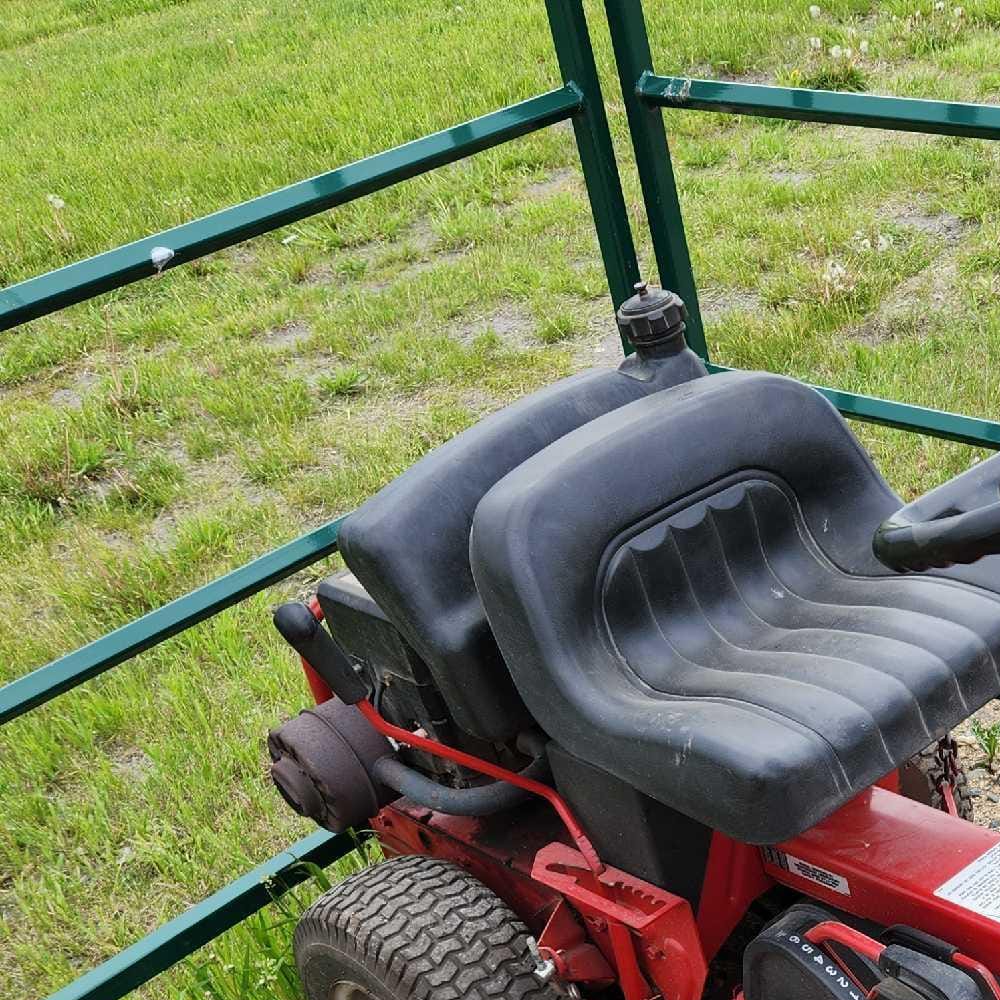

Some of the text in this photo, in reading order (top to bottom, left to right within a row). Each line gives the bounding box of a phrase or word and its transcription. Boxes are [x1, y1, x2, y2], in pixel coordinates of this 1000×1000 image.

[801, 943, 814, 954] 5
[813, 955, 824, 965] 4
[825, 965, 837, 976] 3
[836, 977, 849, 988] 2
[849, 991, 859, 1000] 1
